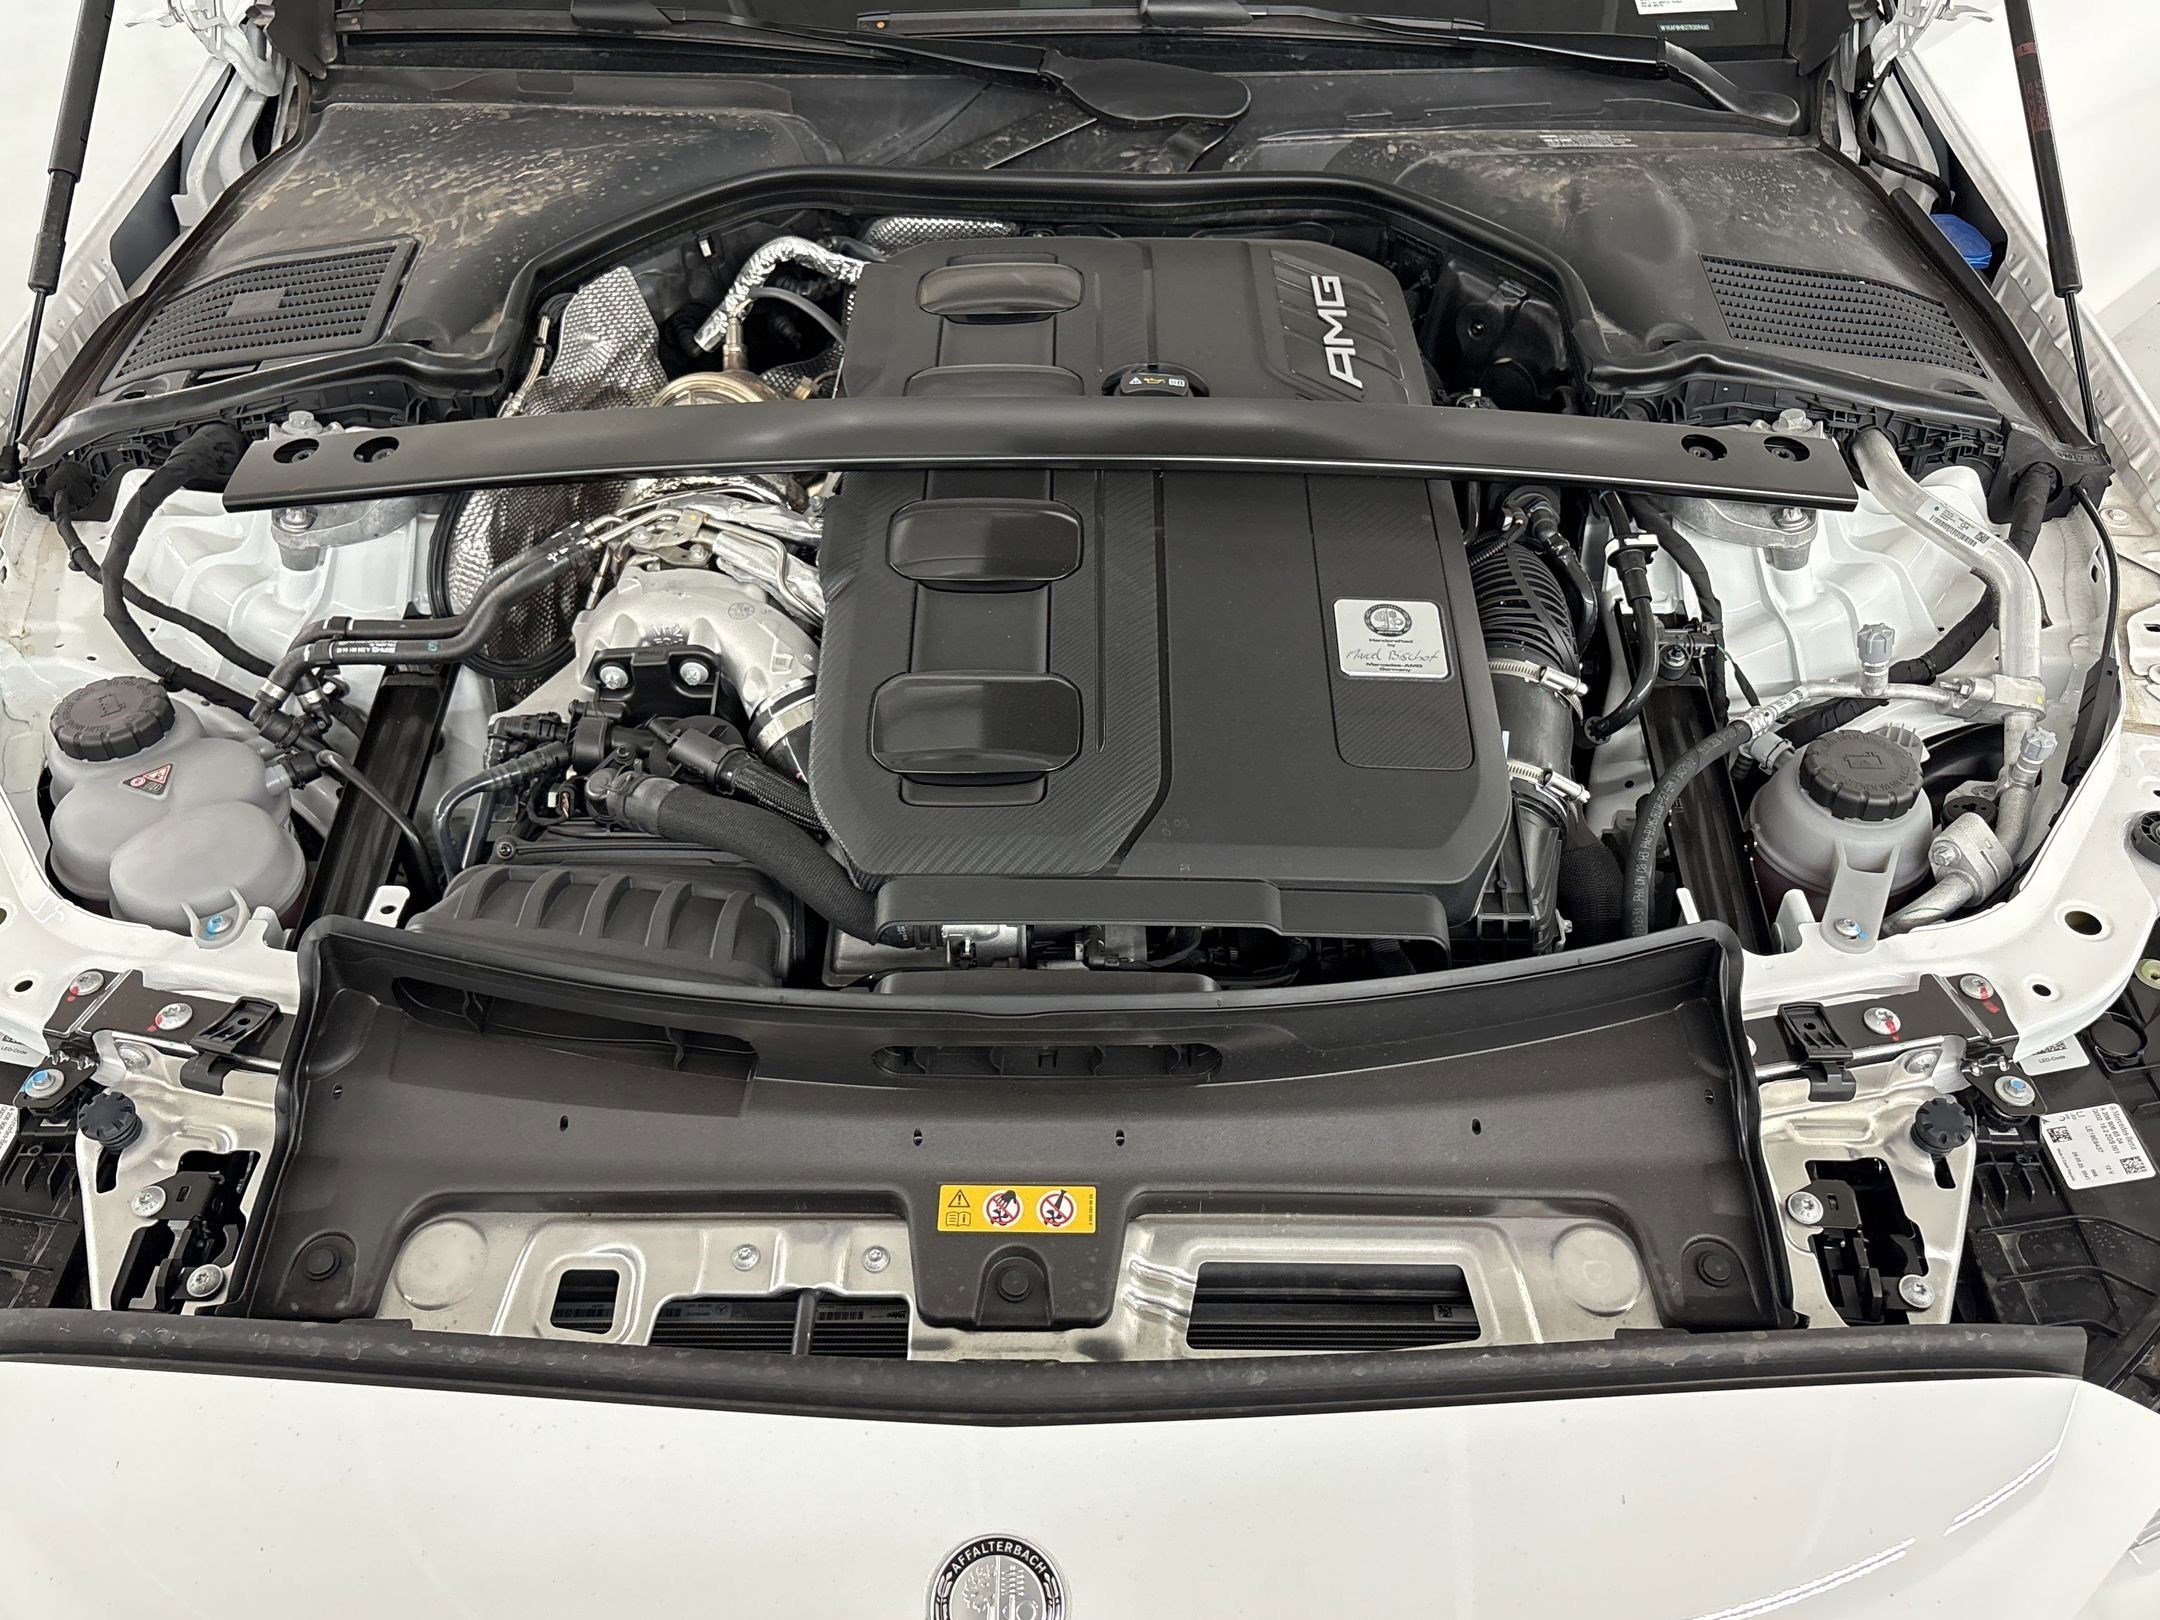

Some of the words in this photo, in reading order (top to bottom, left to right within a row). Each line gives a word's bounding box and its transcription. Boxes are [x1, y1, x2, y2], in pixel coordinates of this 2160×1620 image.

[1311, 276, 1363, 388] AMG
[2111, 1110, 2138, 1150] Mercedes-Benz
[951, 1540, 1047, 1574] AFFALTERBACH
